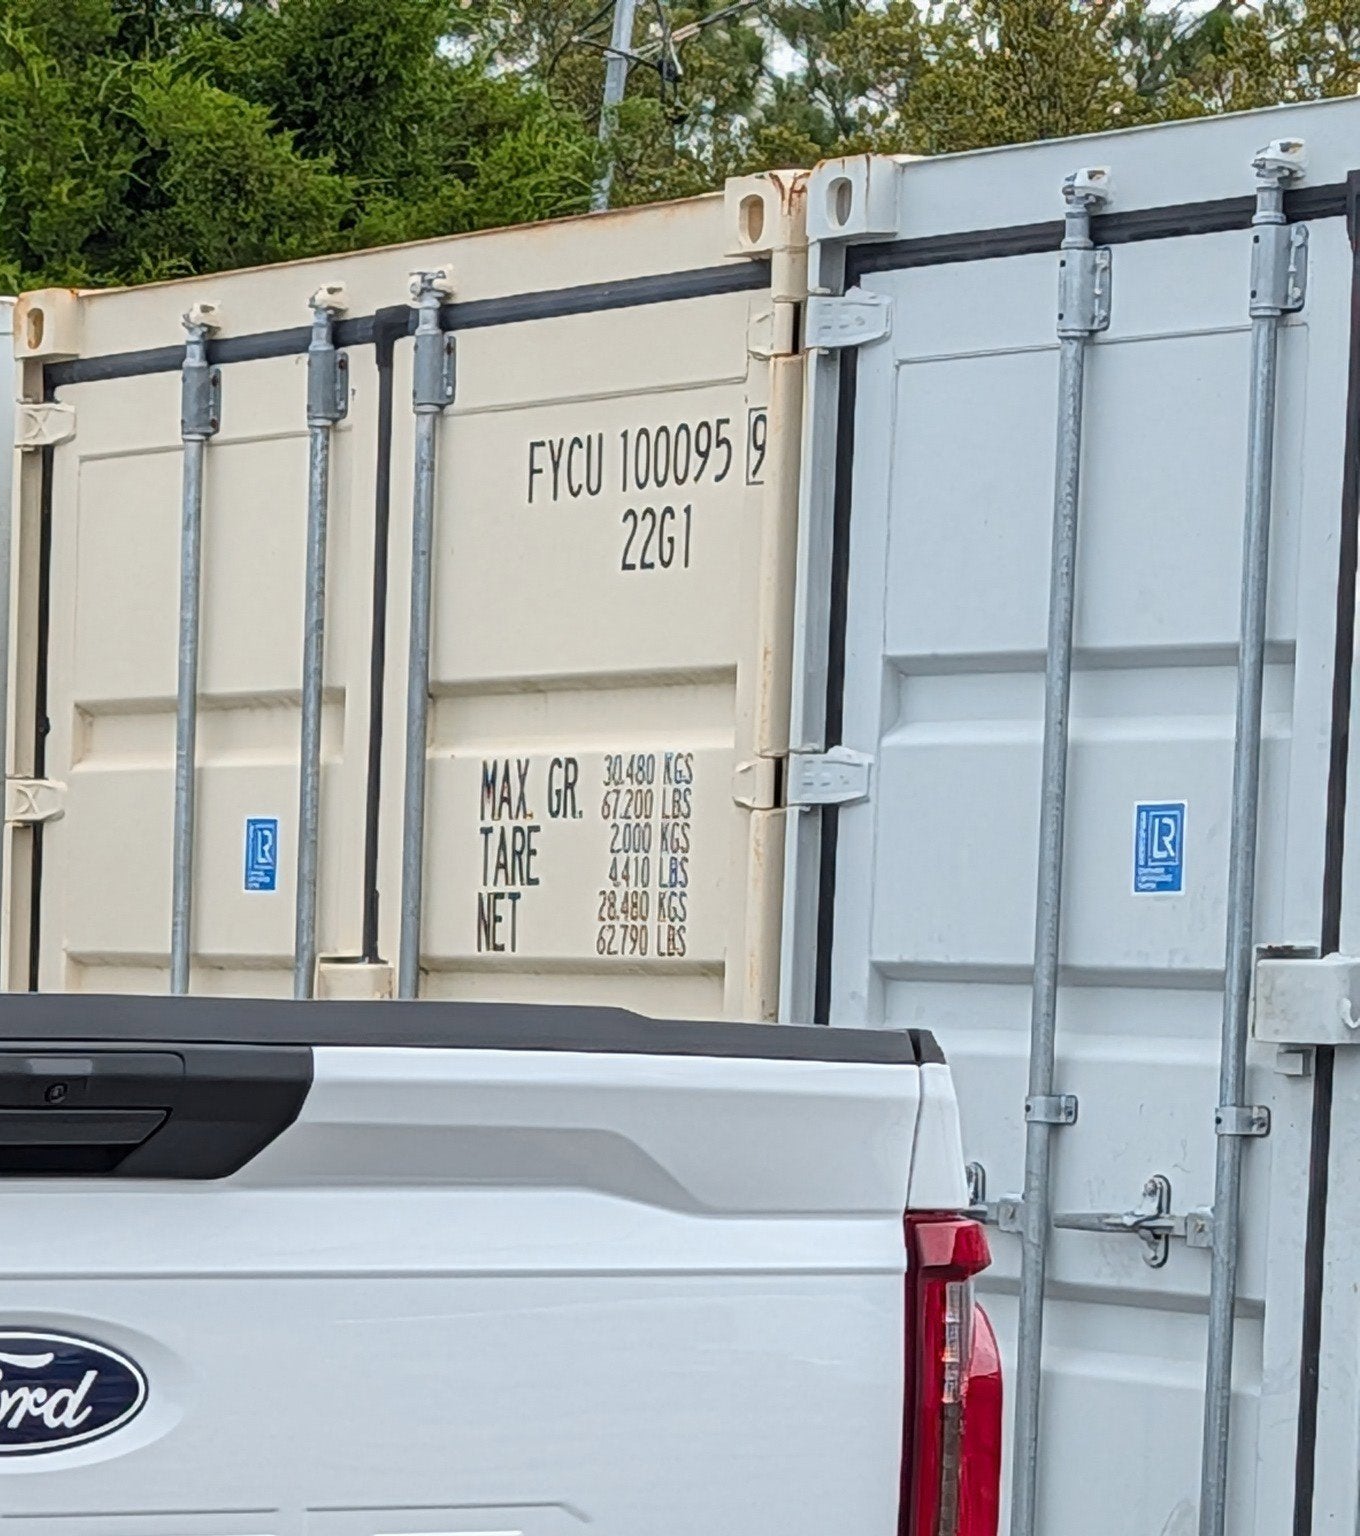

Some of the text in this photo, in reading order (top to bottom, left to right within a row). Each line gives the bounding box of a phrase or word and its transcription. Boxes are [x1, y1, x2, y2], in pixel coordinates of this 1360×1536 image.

[528, 432, 603, 503] FYCU
[620, 417, 733, 492] 100095
[621, 503, 692, 571] 22G1
[662, 752, 694, 785] KGS
[480, 757, 583, 821] MAX. GR.
[660, 787, 692, 820] LBS
[660, 822, 691, 854] KGS
[479, 825, 541, 886] TARE
[658, 856, 689, 888] LBS
[477, 891, 522, 953] NET
[656, 890, 688, 922] KGS
[656, 924, 687, 957] LBS
